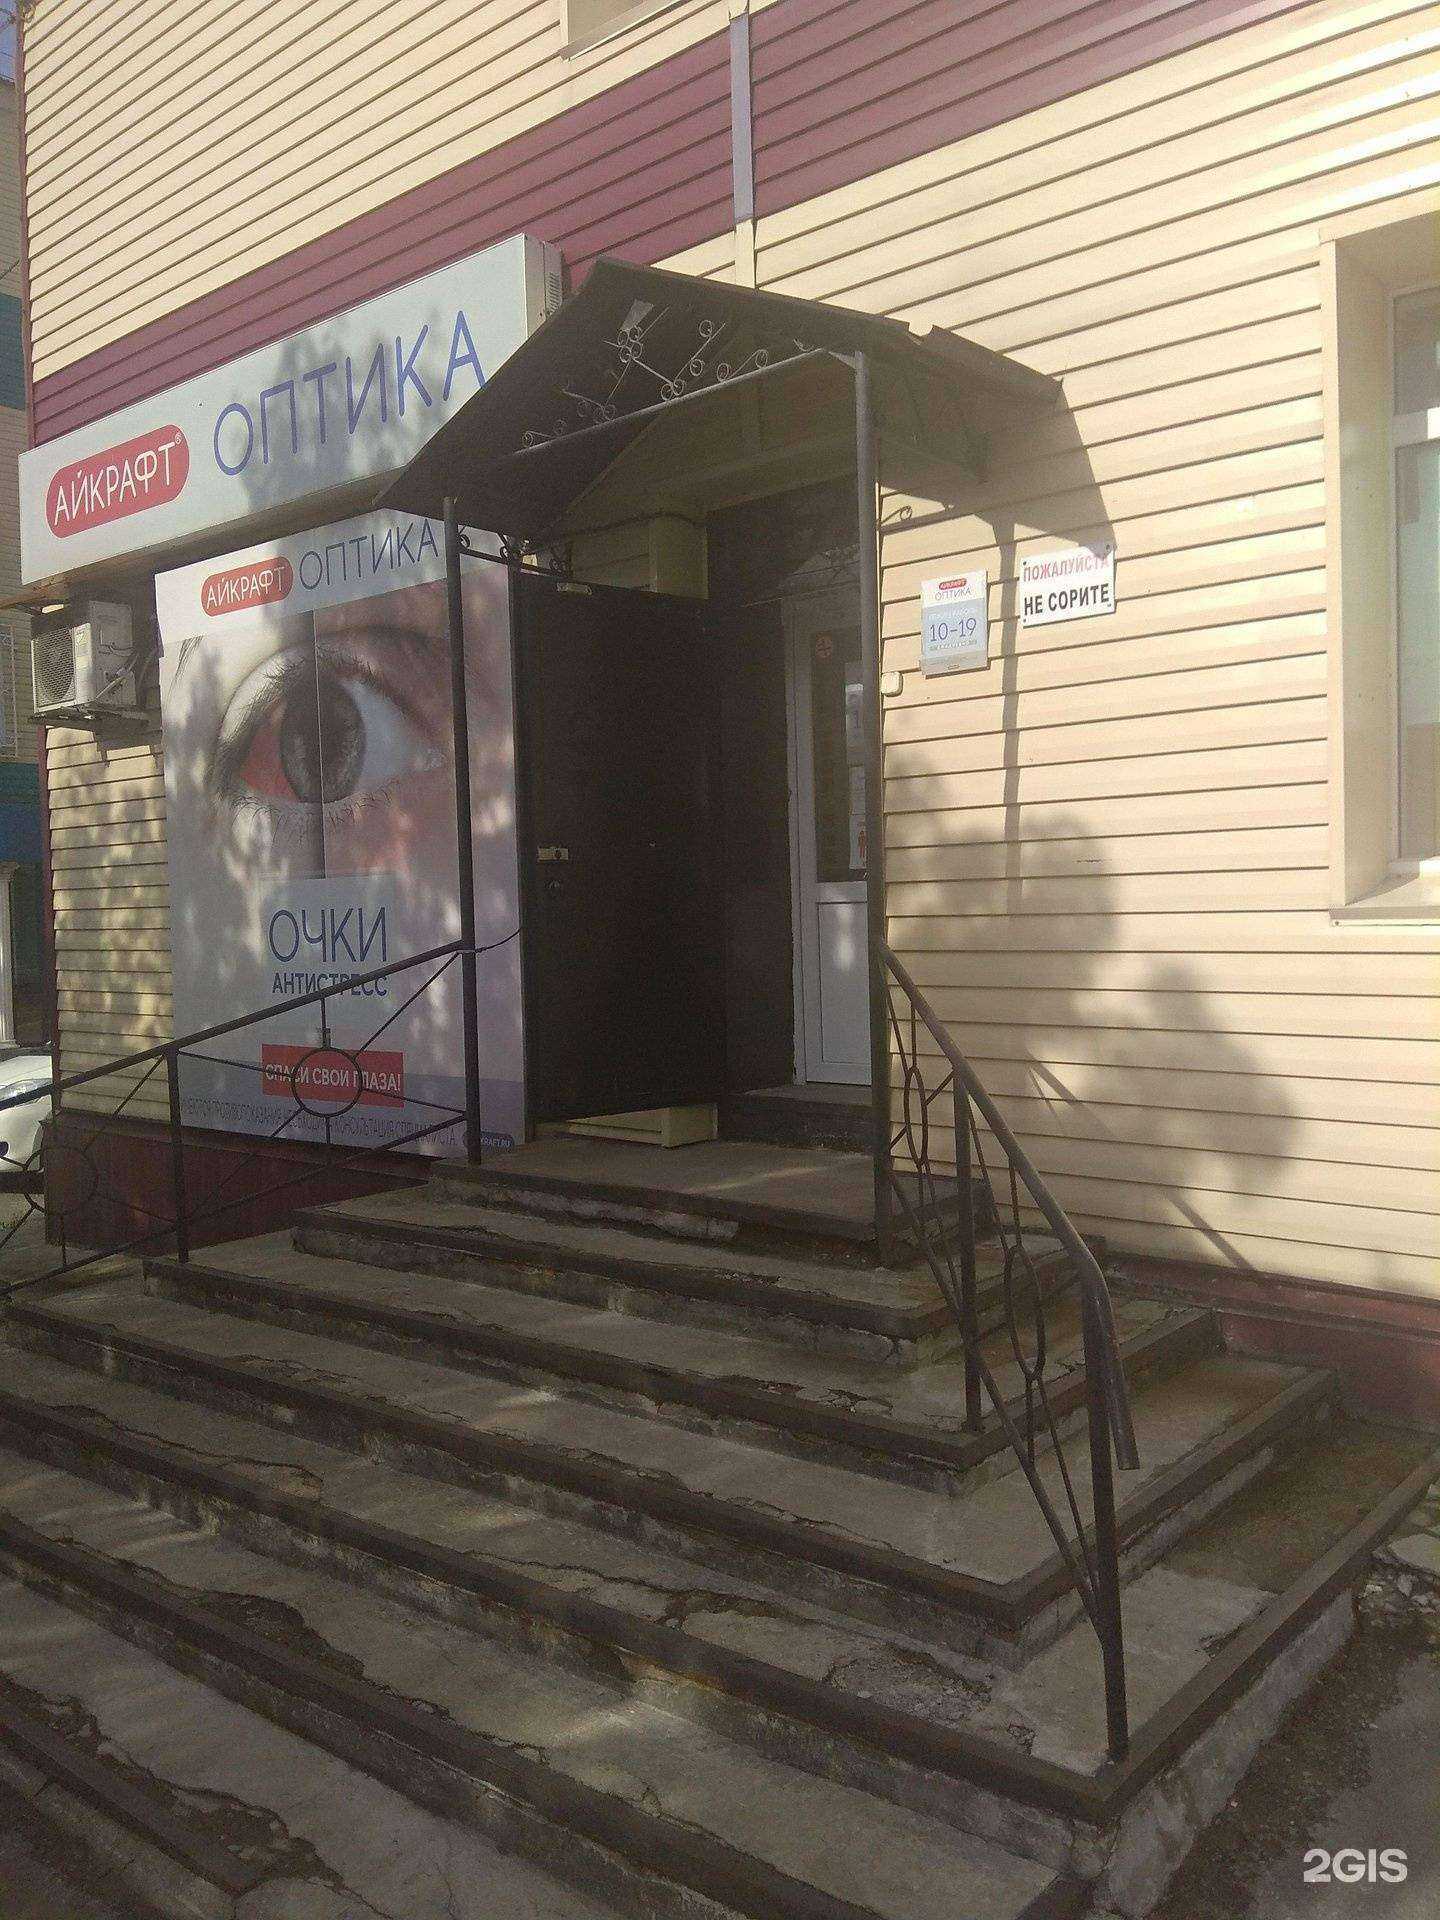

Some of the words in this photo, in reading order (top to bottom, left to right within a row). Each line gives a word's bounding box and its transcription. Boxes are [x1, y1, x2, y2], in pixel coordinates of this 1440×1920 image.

[213, 310, 486, 477] ОПТИКА
[206, 566, 286, 610] АЙКРАФТ
[298, 518, 439, 590] ОПТИКА
[934, 586, 972, 601] ОПТИКА
[1023, 594, 1043, 616] НЕ
[1048, 582, 1110, 612] СОРИТЕ
[930, 617, 977, 642] 10-19
[268, 906, 388, 964] ОЧКИ
